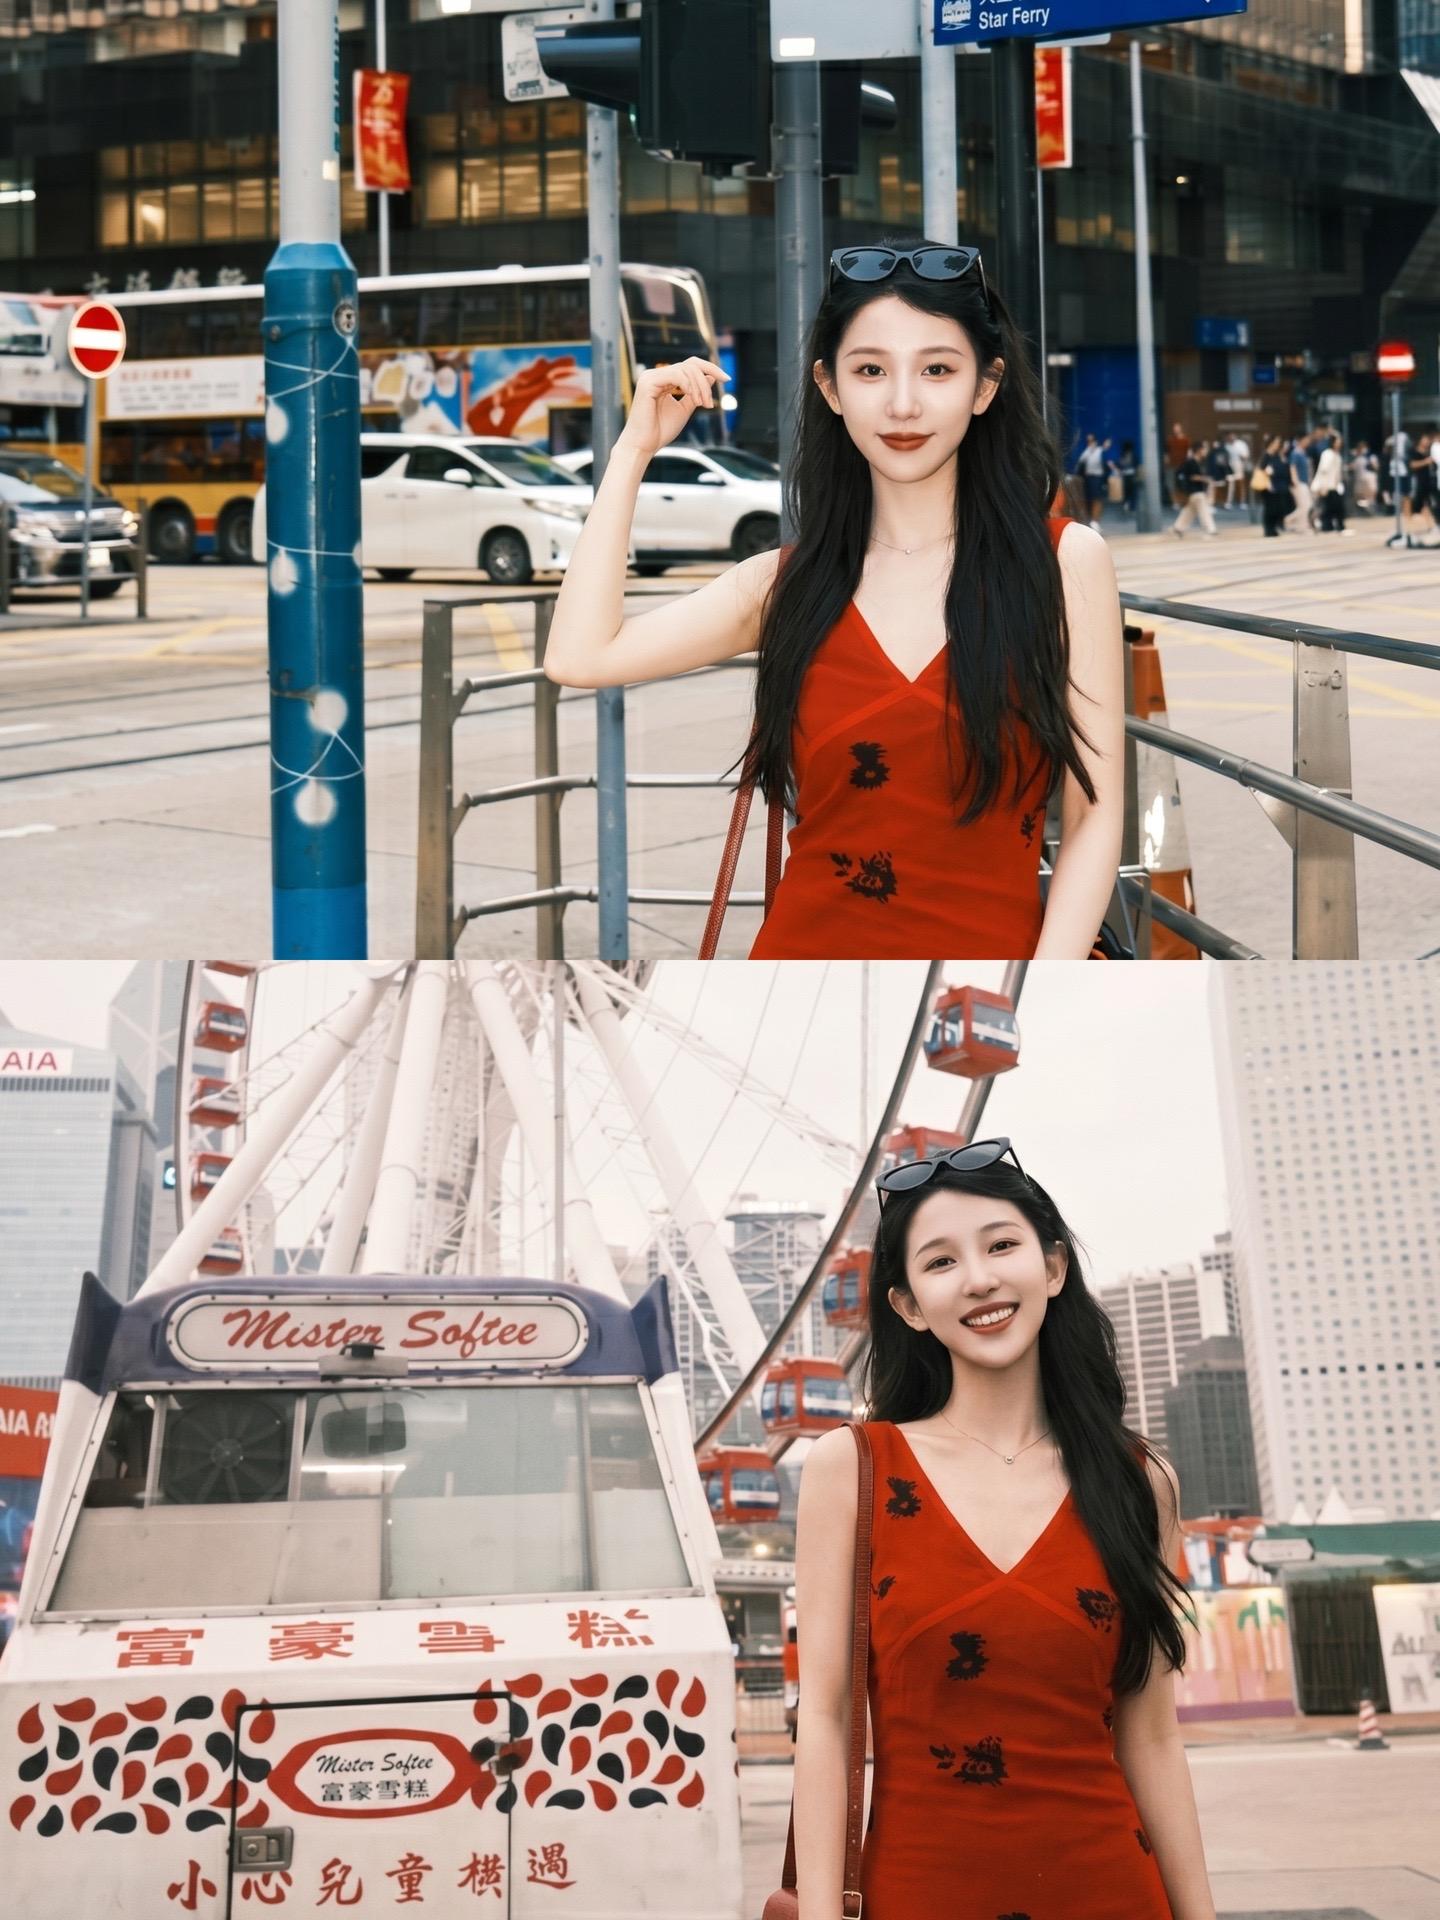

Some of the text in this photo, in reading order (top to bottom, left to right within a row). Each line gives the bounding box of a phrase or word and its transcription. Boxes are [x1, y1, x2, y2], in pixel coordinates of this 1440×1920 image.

[978, 7, 1050, 29] Star Ferry
[2, 1051, 57, 1071] AIA
[222, 1308, 538, 1359] Mister Softee
[116, 1608, 655, 1669] 富豪雪糕
[316, 1752, 433, 1776] Mister Softee
[321, 1778, 430, 1802] 富豪雪糕
